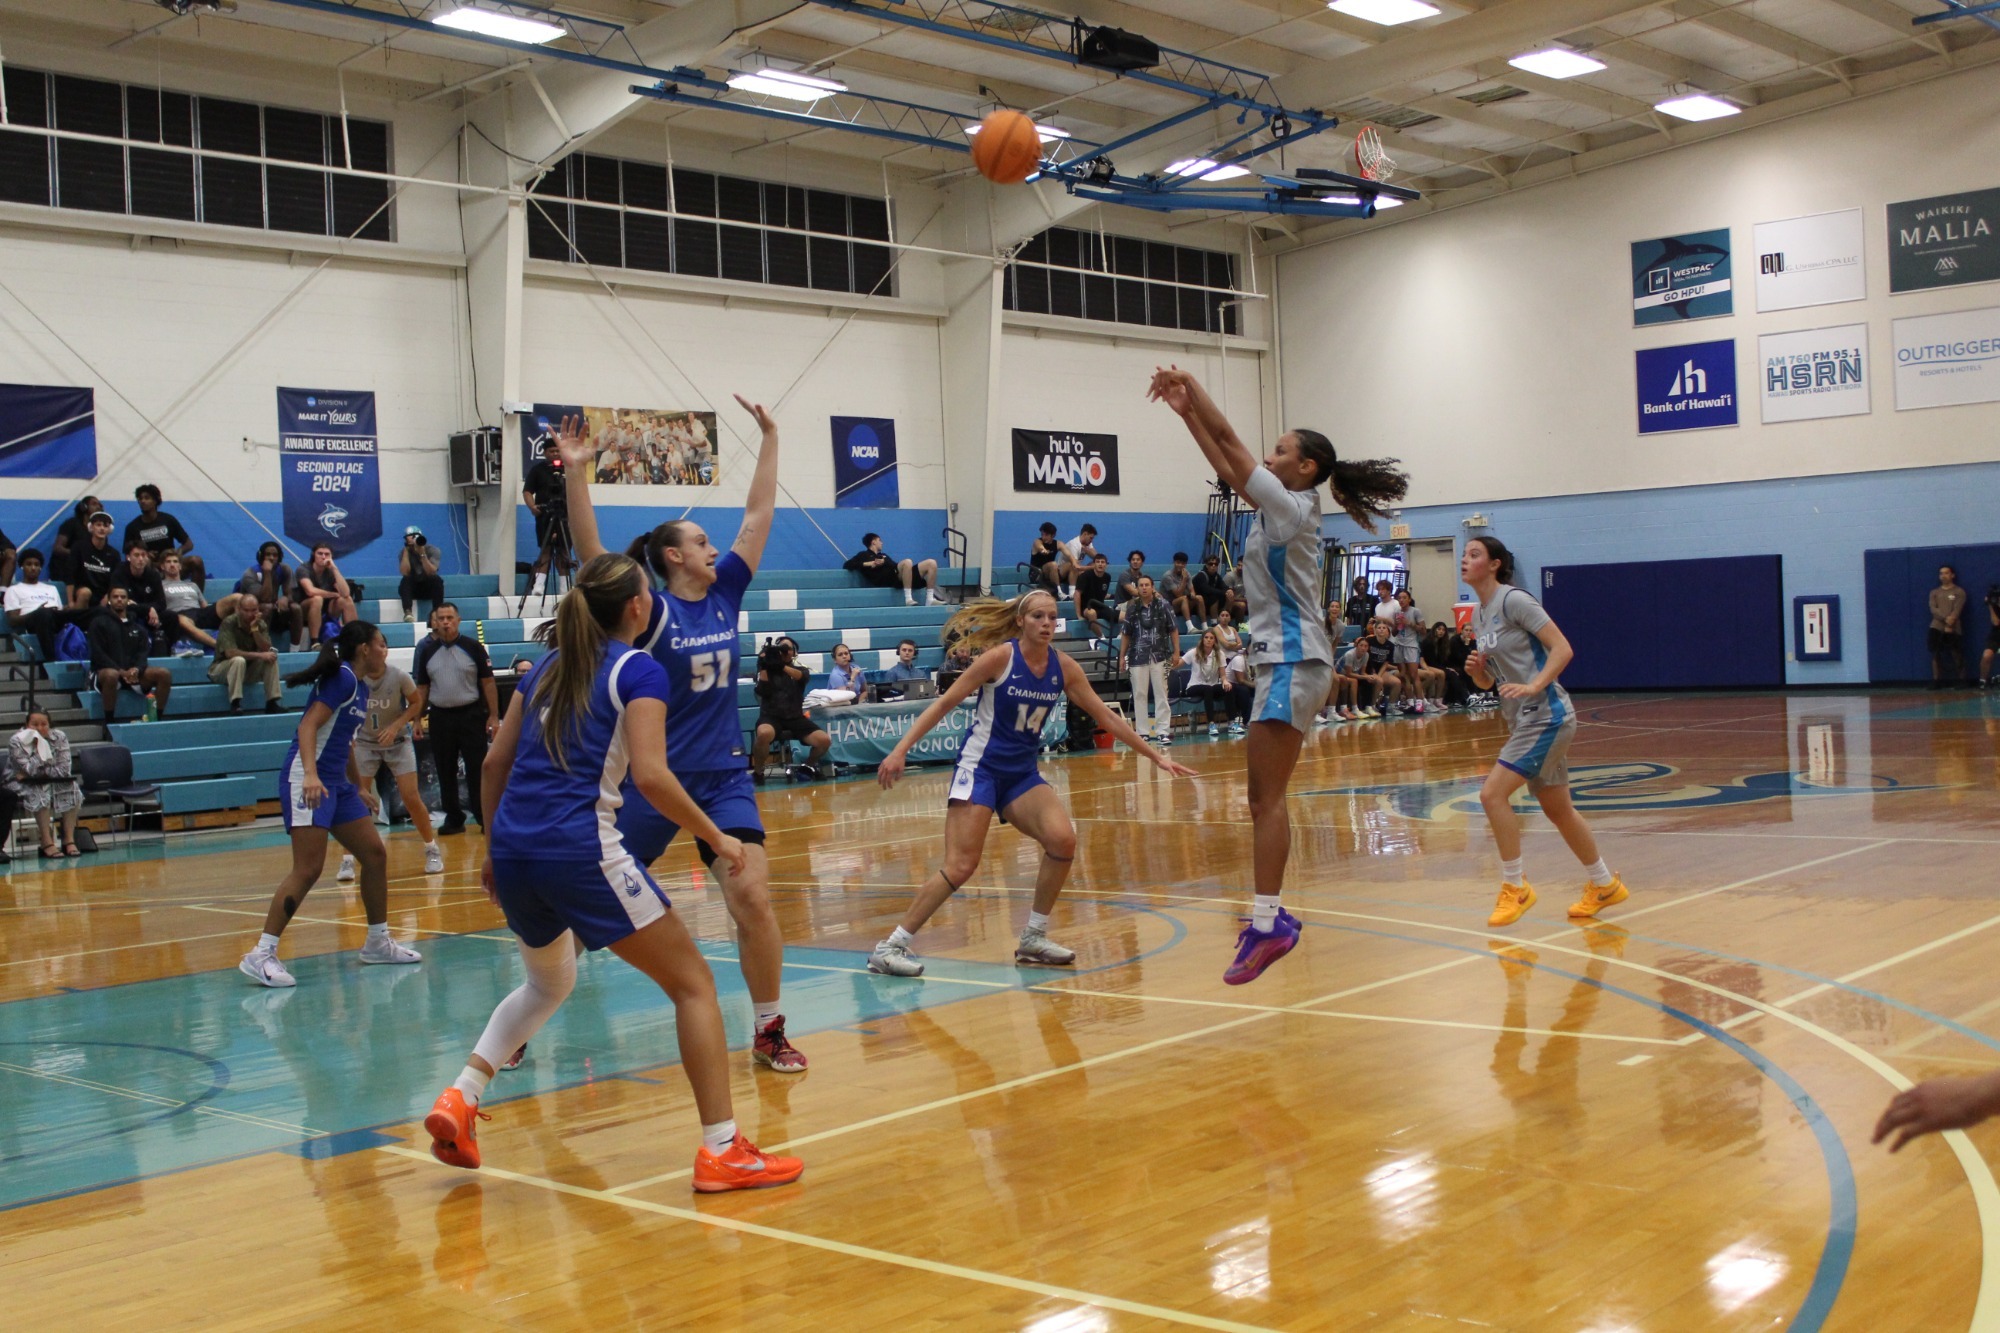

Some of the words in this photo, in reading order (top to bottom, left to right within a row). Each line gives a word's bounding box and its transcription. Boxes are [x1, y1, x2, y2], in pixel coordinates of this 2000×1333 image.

[1900, 217, 1991, 247] MALIA
[1673, 264, 1711, 277] WESTPAC
[1664, 292, 1679, 302] GO
[1681, 285, 1705, 299] HPU!
[1767, 356, 1785, 367] AM
[1788, 354, 1811, 365] 760
[1812, 351, 1830, 362] FM
[1833, 347, 1861, 360] 95.1
[1898, 338, 2000, 362] OUTRIGGER
[1767, 357, 1862, 392] HSRN
[1920, 367, 1949, 377] RESORTS
[1956, 364, 1982, 373] HOTELS
[1789, 388, 1812, 396] SPORTS
[1813, 386, 1831, 394] RADIO
[1643, 401, 1673, 415] Bank
[1674, 399, 1688, 412] of
[298, 412, 319, 421] MAKE
[320, 413, 327, 421] IT
[327, 409, 357, 425] YOURS
[285, 437, 314, 450] AWARD
[315, 439, 325, 450] OF
[326, 439, 374, 452] EXCELLENCE
[851, 445, 879, 458] NCAA
[1049, 435, 1071, 454] hui
[296, 461, 334, 474] SECOND
[336, 462, 364, 474] PLACE
[312, 475, 351, 492] 2024
[1393, 526, 1406, 537] EXIT
[690, 648, 732, 693] 51
[371, 712, 379, 730] 1
[934, 707, 979, 732] ACIF
[1014, 703, 1049, 734] 14
